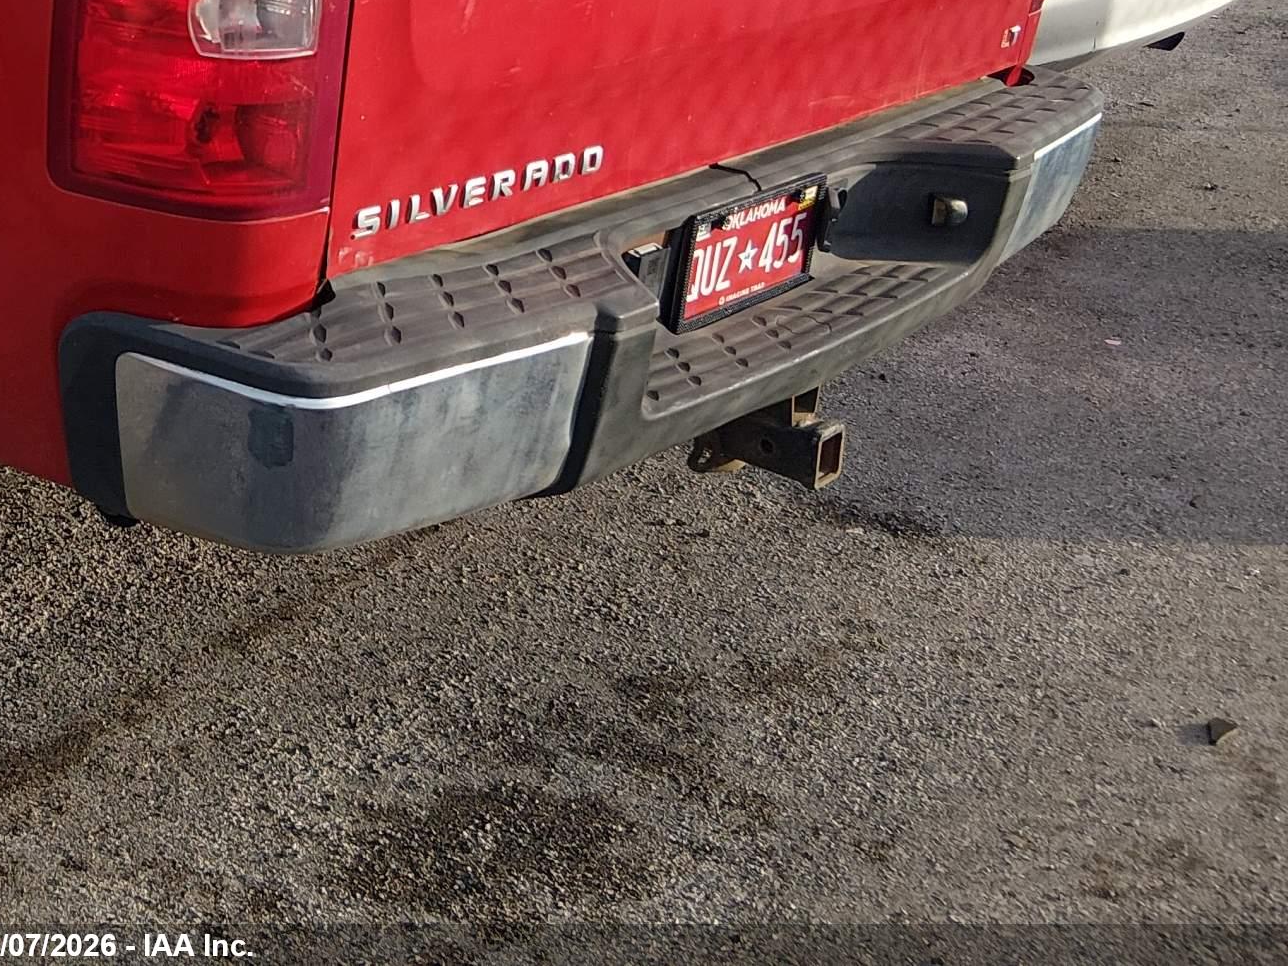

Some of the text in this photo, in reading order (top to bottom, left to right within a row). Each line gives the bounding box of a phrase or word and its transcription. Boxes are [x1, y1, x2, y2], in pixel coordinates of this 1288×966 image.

[349, 144, 605, 241] SILVERADO
[723, 198, 787, 231] OKLAHOMA
[758, 212, 808, 273] 455
